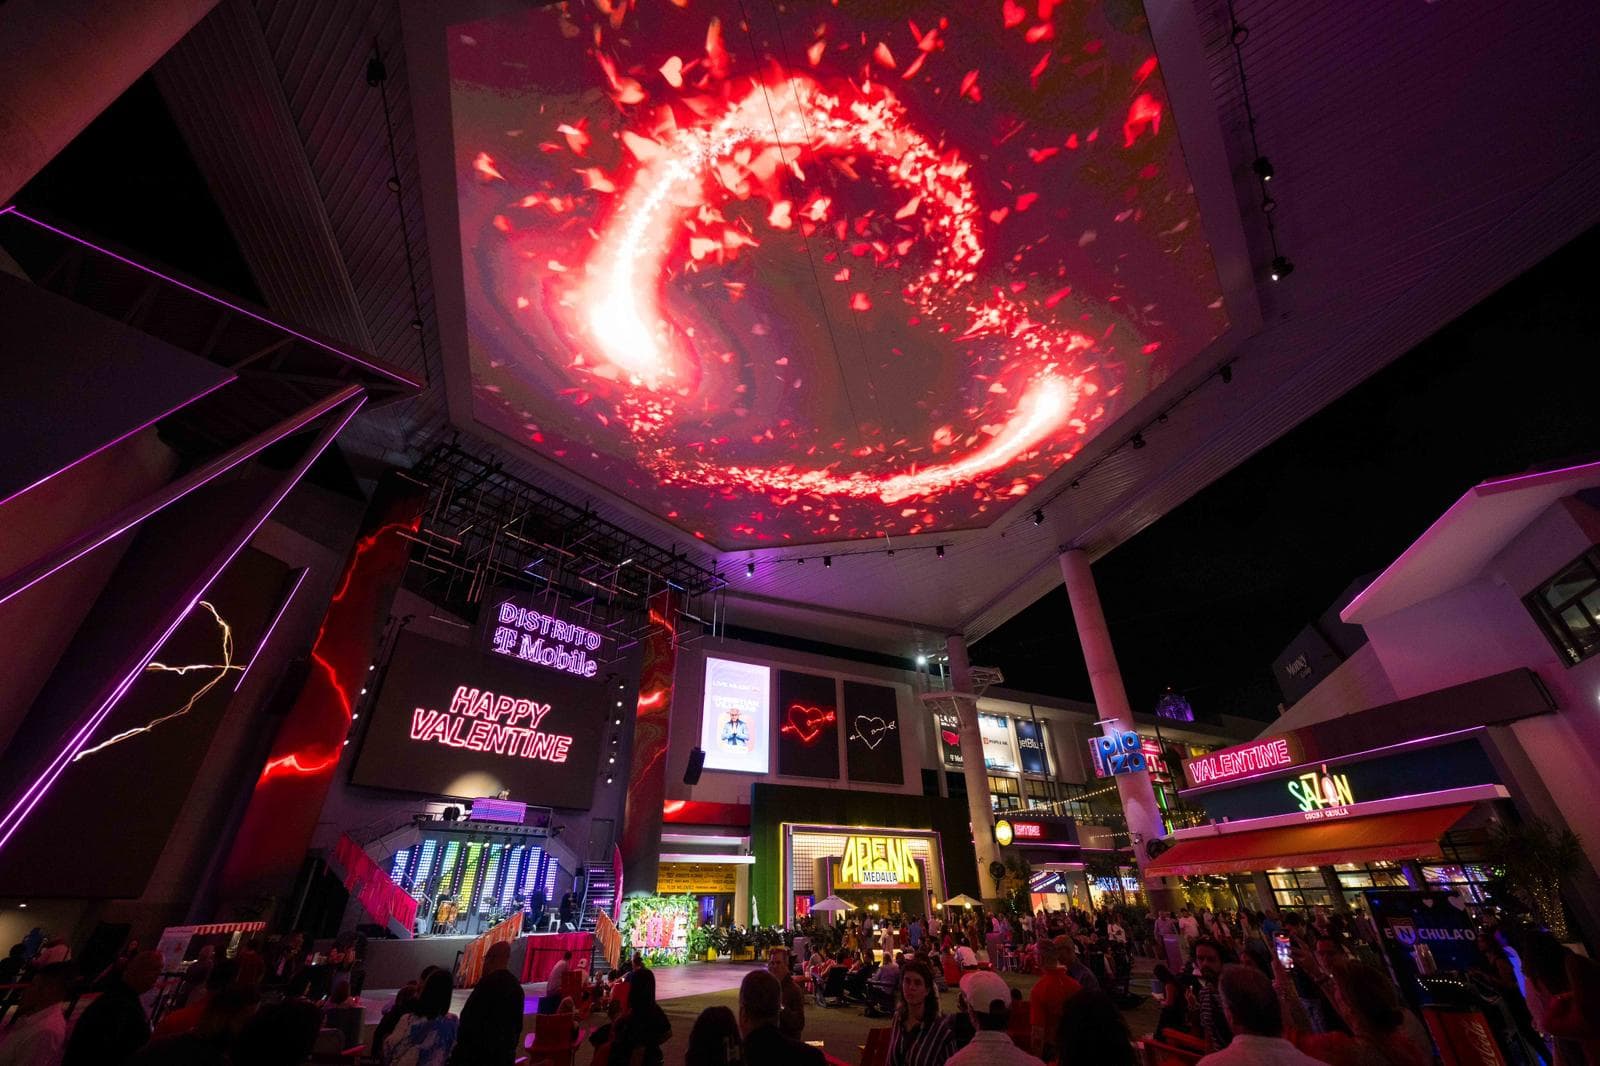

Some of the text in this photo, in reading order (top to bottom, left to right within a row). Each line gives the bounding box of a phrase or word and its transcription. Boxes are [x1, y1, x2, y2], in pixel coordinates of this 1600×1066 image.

[498, 602, 601, 650] DISTRITO
[519, 633, 597, 677] Mobile
[449, 686, 551, 729] HAPPY
[410, 708, 573, 763] VALENTINE
[1189, 739, 1291, 784] VALENTINE
[841, 836, 920, 883] ARENA
[863, 871, 898, 882] MEDALLA
